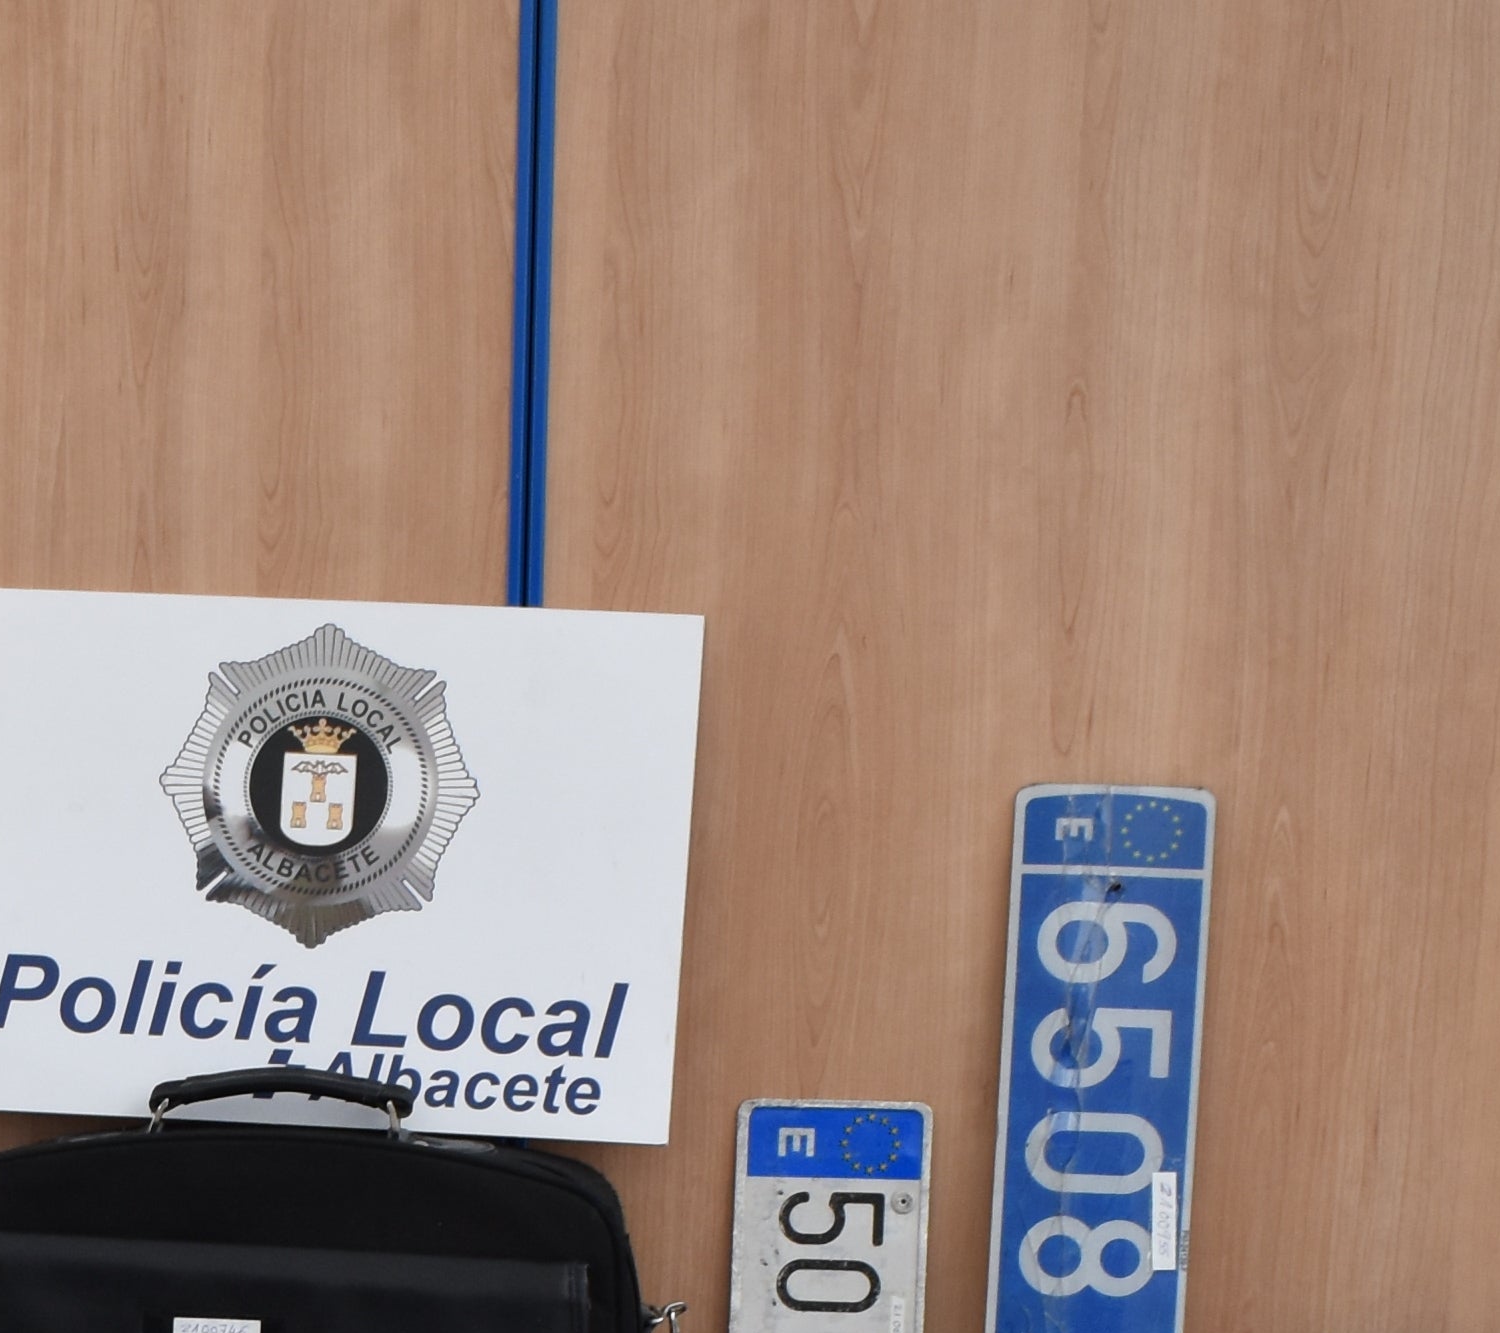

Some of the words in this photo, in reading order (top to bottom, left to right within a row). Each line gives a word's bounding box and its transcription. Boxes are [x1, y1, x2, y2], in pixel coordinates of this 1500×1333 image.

[237, 689, 327, 749] POLICIA
[336, 691, 403, 755] LOCAL
[1054, 816, 1095, 842] E
[247, 844, 381, 884] ALBACETE
[349, 969, 630, 1060] Local
[1018, 901, 1178, 1298] 6508
[777, 1126, 816, 1158] E
